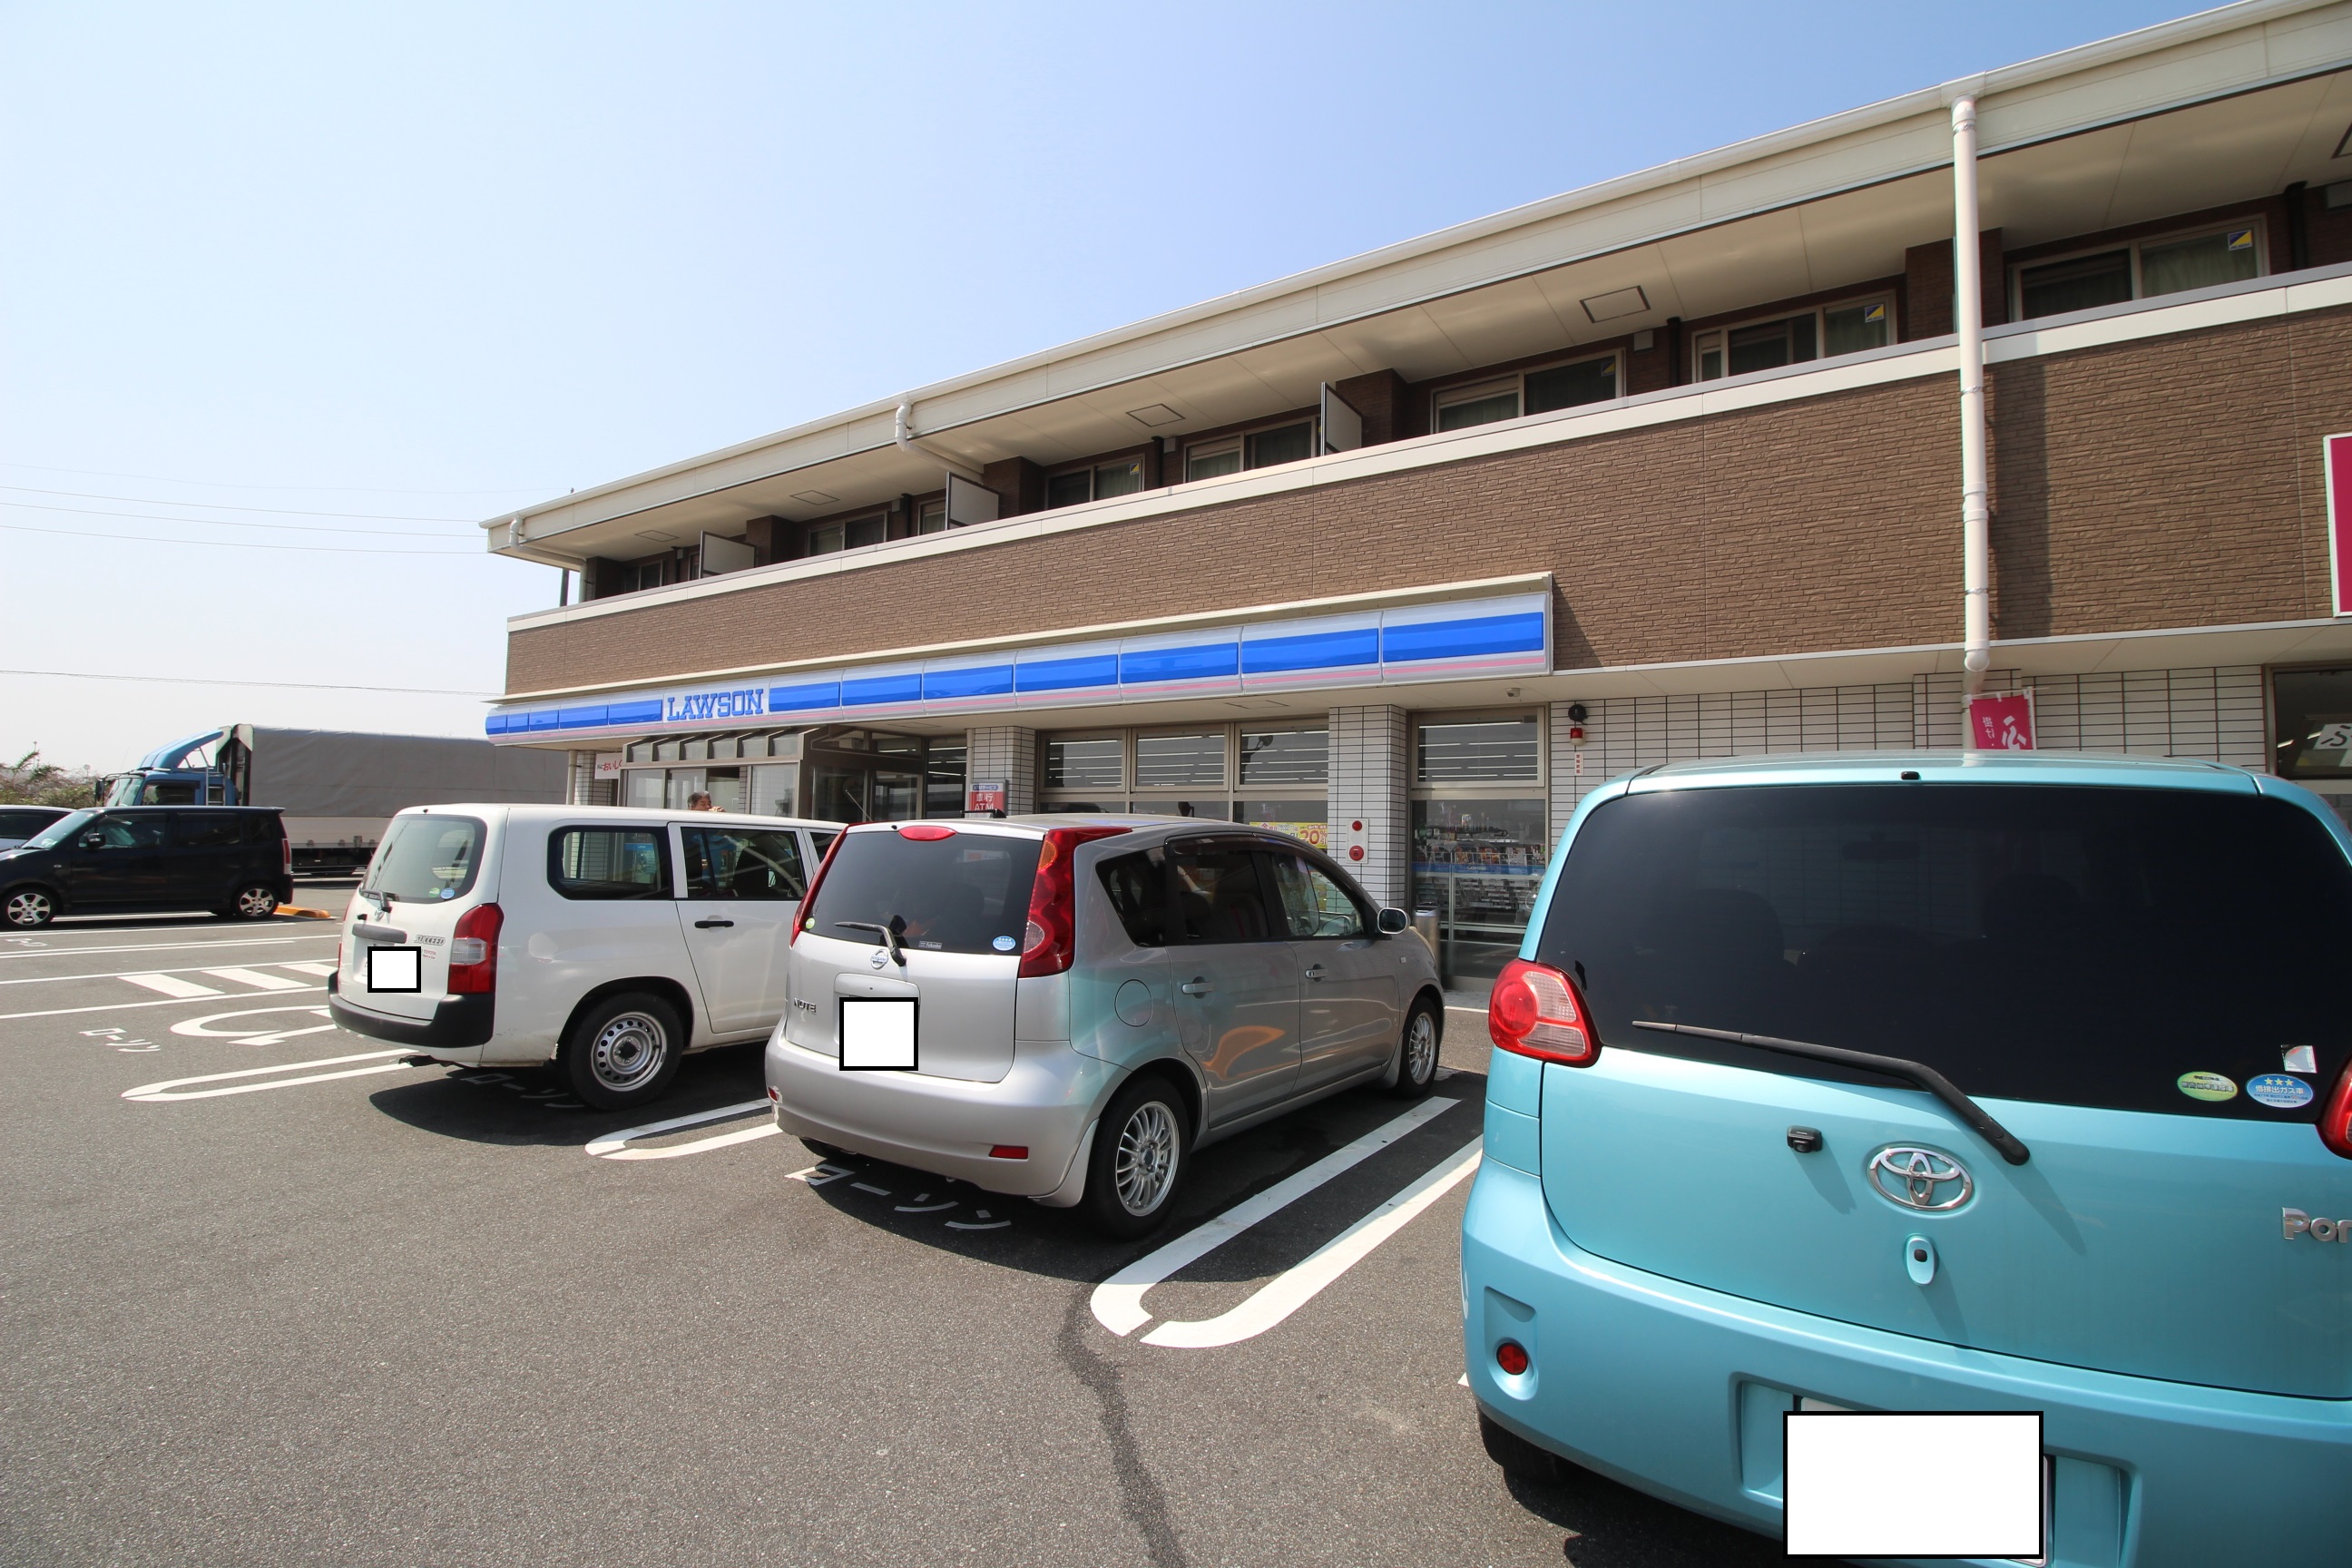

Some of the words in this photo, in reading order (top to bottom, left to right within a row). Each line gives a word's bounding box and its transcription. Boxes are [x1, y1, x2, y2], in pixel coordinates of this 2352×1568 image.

[667, 689, 763, 720] LAWSON
[975, 803, 994, 811] ATM
[414, 935, 446, 946] SUCCEED
[794, 998, 816, 1013] NOTE
